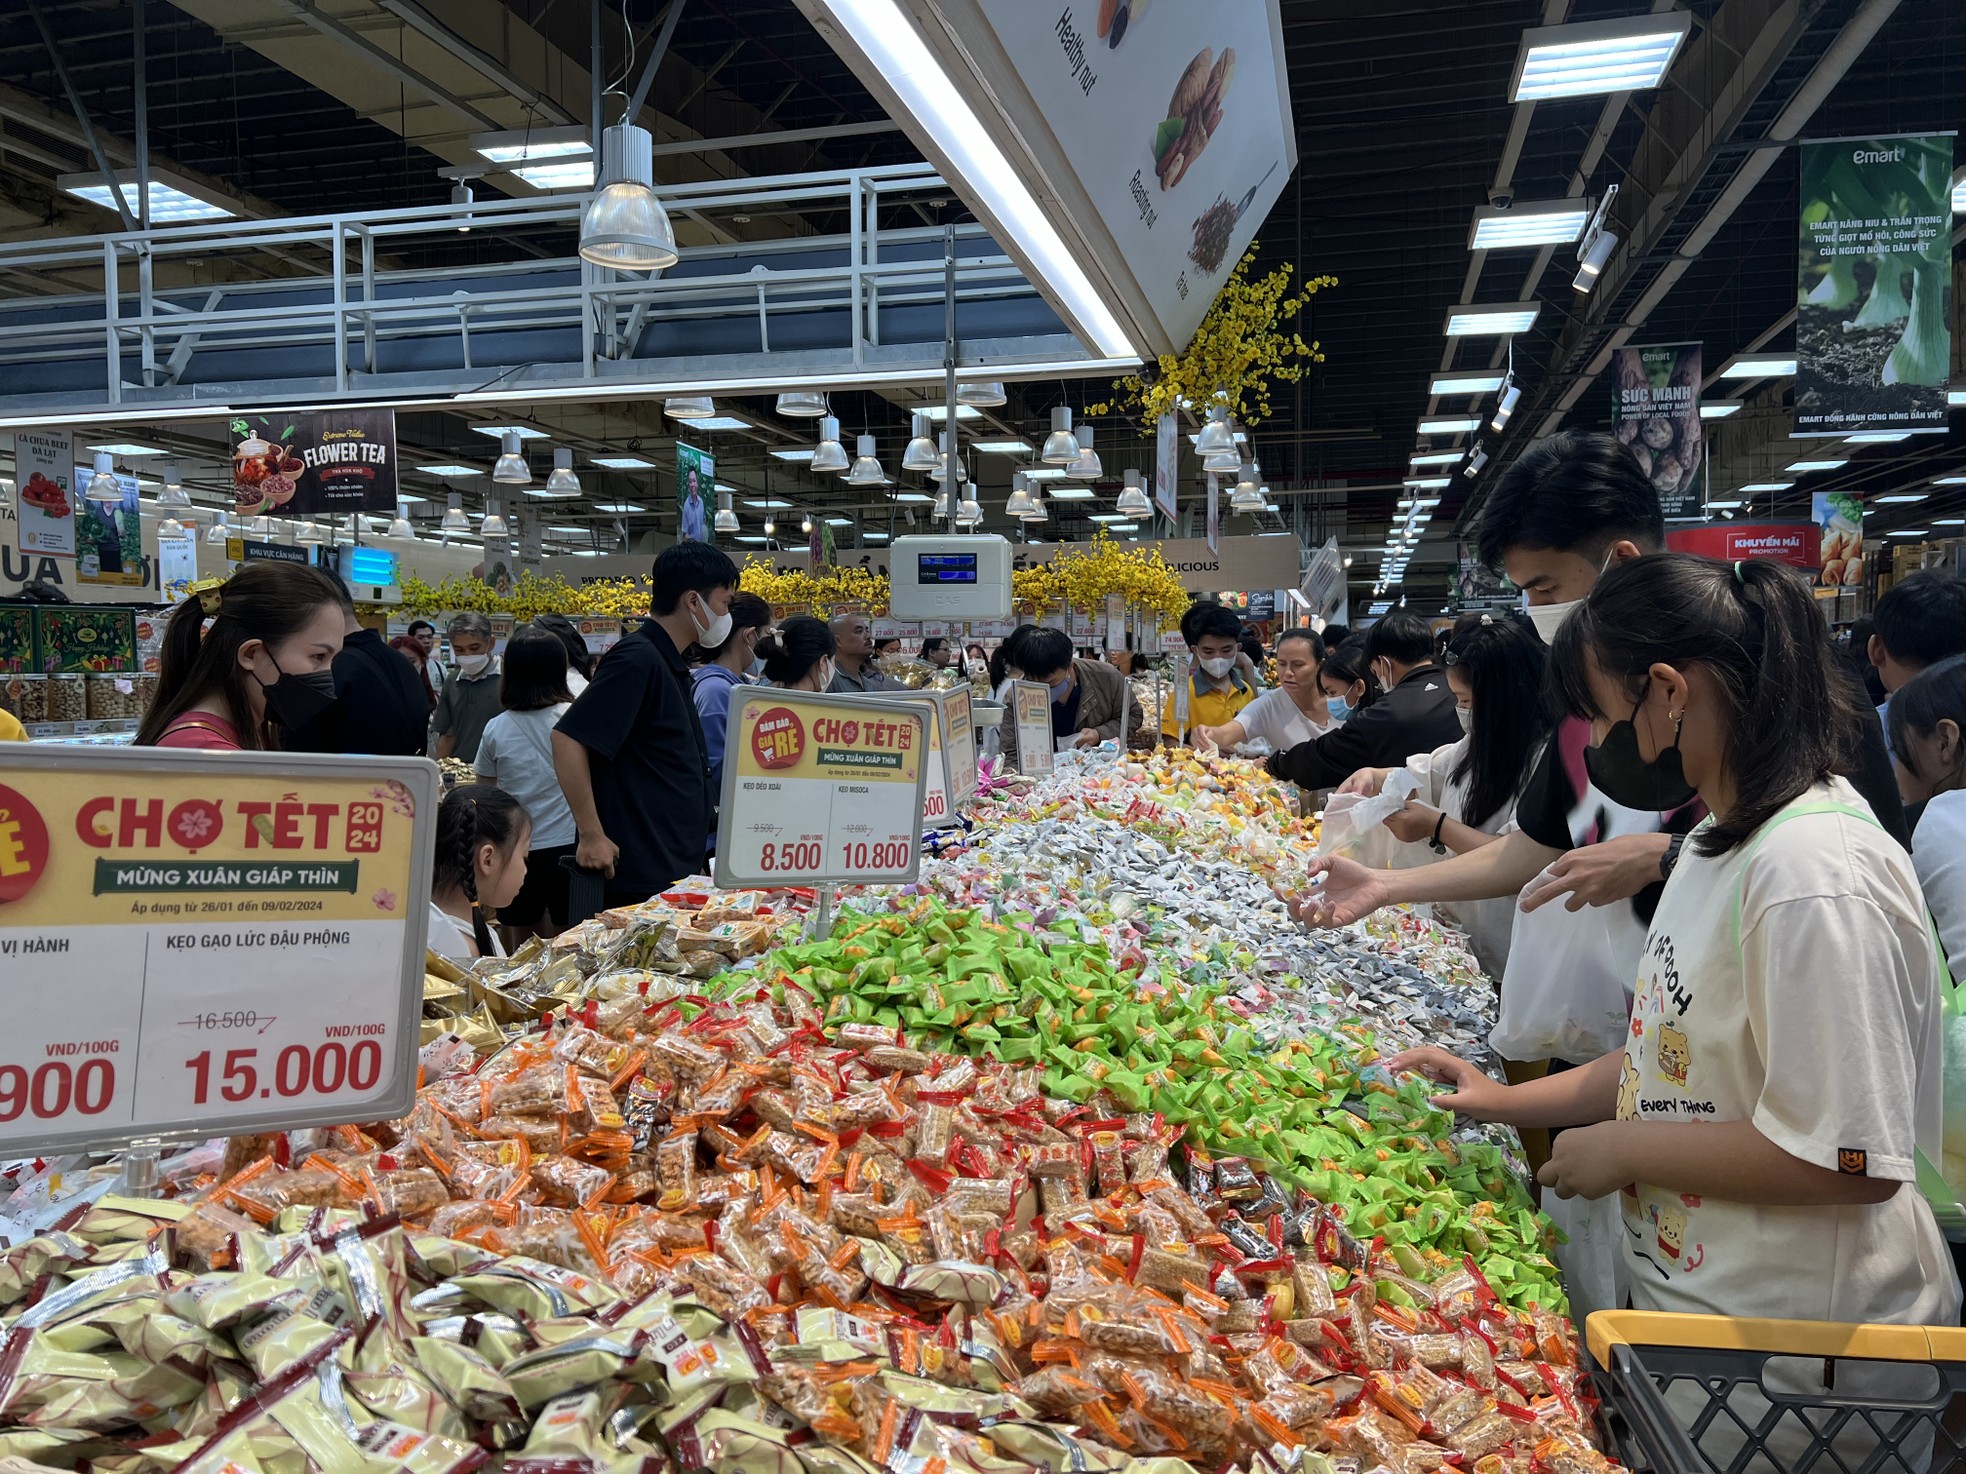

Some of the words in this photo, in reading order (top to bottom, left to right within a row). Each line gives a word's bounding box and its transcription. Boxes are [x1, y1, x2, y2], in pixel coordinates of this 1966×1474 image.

[1055, 7, 1085, 77] Healthy
[1077, 63, 1098, 97] nut
[1853, 146, 1900, 164] emart
[1129, 169, 1150, 220] Roasting
[1144, 208, 1157, 230] nut
[1810, 221, 1838, 231] EMART
[1865, 219, 1879, 227] NIU
[1642, 352, 1670, 361] emart
[1622, 387, 1649, 403] SỨC
[1653, 386, 1691, 402] MẠNH
[303, 442, 358, 468] FLOWER
[360, 443, 386, 464] TEA
[1735, 535, 1780, 548] KHUYẾN
[1783, 536, 1799, 546] MÃI
[775, 723, 799, 758] RẺ
[813, 718, 859, 747] CHỢ
[863, 719, 897, 747] TẾT
[901, 726, 911, 736] 20
[900, 738, 910, 747] 24
[75, 796, 223, 854] CHỢ
[237, 792, 339, 849] TẾT
[351, 806, 379, 824] 20
[349, 830, 378, 848] 24
[761, 842, 821, 871] 8.500
[843, 842, 908, 869] 10.800
[117, 866, 181, 885] MỪNG
[186, 866, 241, 885] XUÂN
[246, 866, 293, 884] GIÁP
[298, 866, 339, 884] THÌN
[131, 901, 147, 915] Áp
[151, 901, 181, 916] dụng
[185, 901, 197, 912] từ
[201, 901, 233, 912] 26/01
[237, 900, 258, 911] đến
[262, 901, 323, 911] 09/02/2024
[1, 939, 17, 957] VỊ
[23, 936, 69, 952] HÀNH
[167, 935, 196, 952] KẸO
[201, 934, 231, 951] GẠO
[236, 930, 266, 947] LỨC
[270, 929, 300, 949] ĐẬU
[303, 929, 350, 948] PHỘNG
[195, 1010, 256, 1029] 16.500
[325, 1024, 385, 1038] VND/100G
[46, 1040, 119, 1056] VND/100G
[185, 1040, 382, 1104] 15.000
